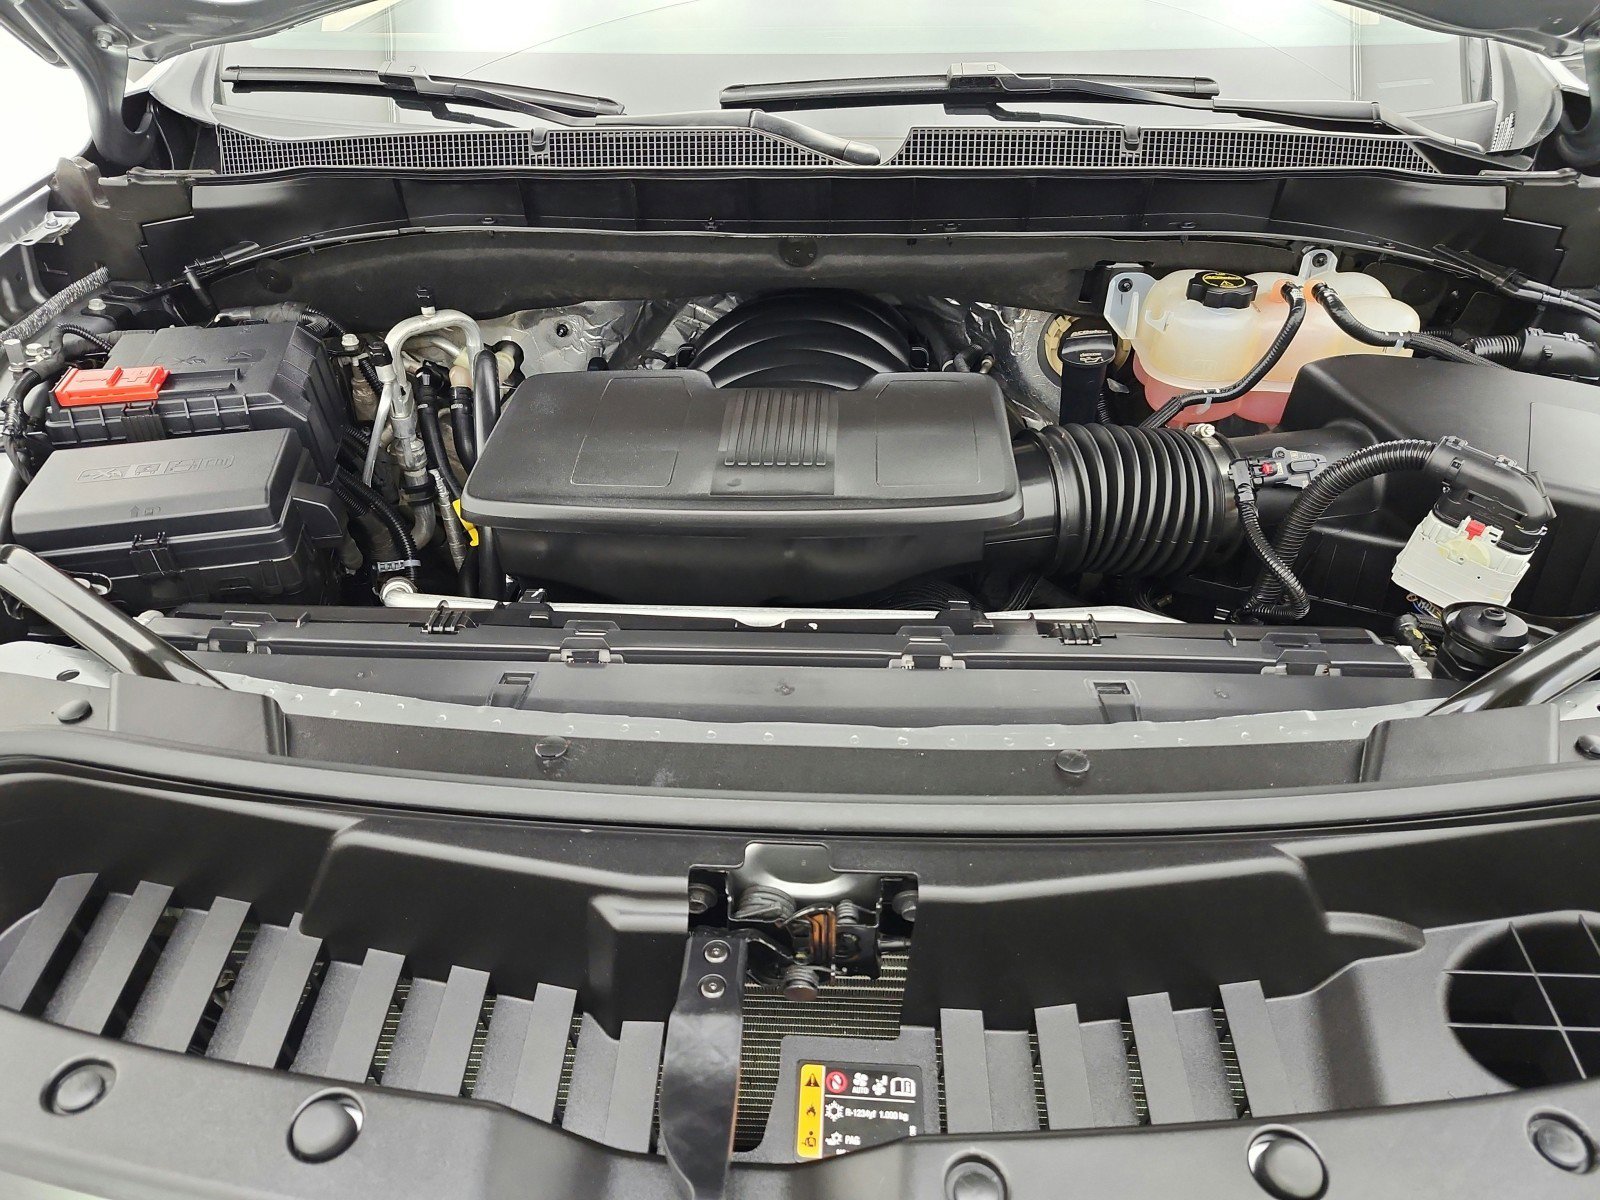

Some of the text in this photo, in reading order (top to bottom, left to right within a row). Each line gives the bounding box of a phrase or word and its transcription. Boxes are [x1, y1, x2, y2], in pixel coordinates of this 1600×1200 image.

[1070, 329, 1108, 337] ACDelco
[851, 1086, 870, 1095] AUTO
[898, 1112, 909, 1122] kg
[844, 1135, 861, 1146] PAG
